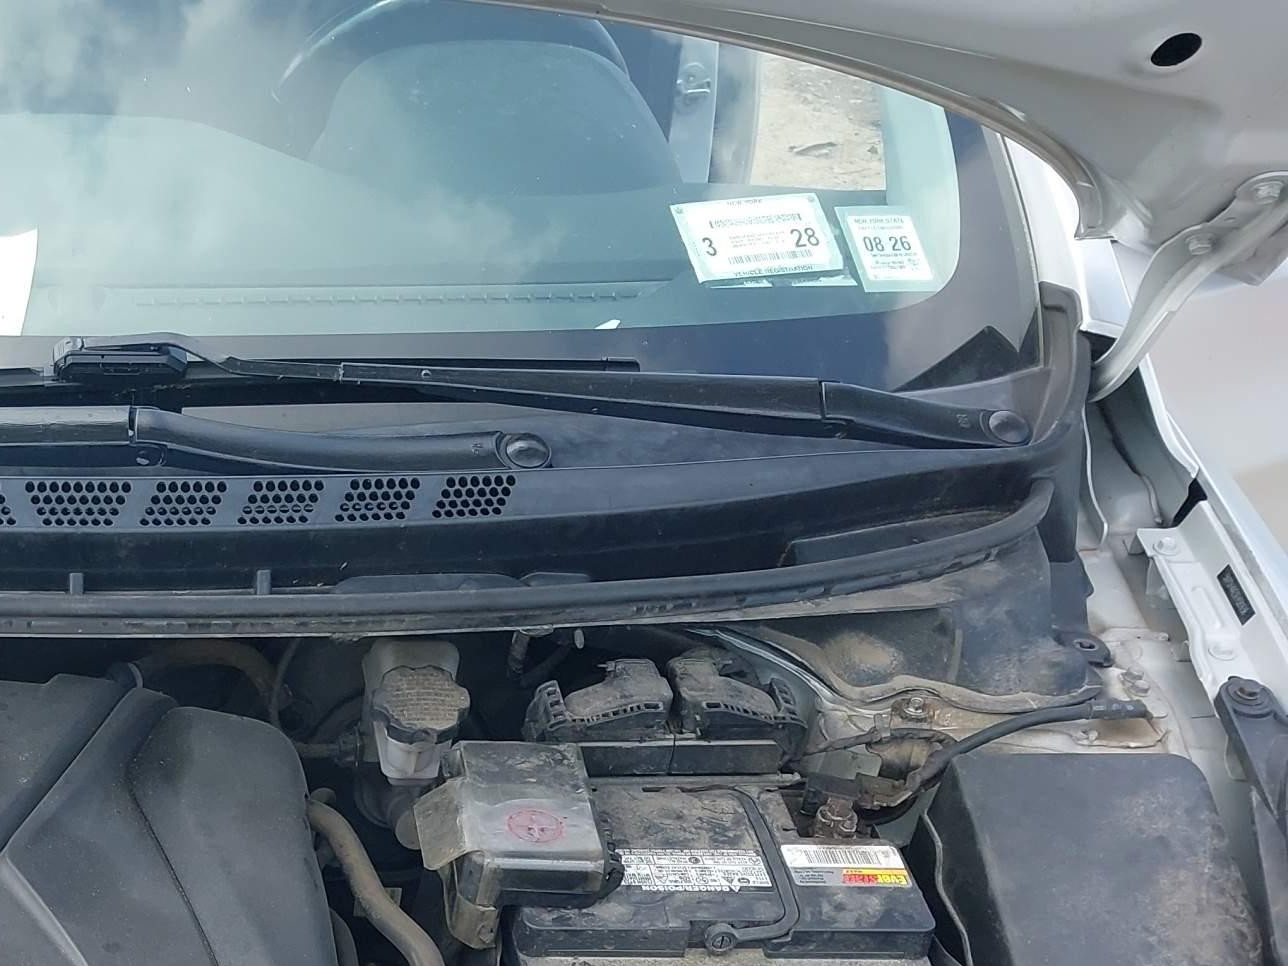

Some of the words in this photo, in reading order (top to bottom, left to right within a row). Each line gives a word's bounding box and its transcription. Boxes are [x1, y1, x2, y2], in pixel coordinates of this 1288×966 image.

[702, 237, 717, 257] 3
[790, 227, 820, 248] 28
[863, 236, 884, 252] 08
[889, 235, 911, 252] 26
